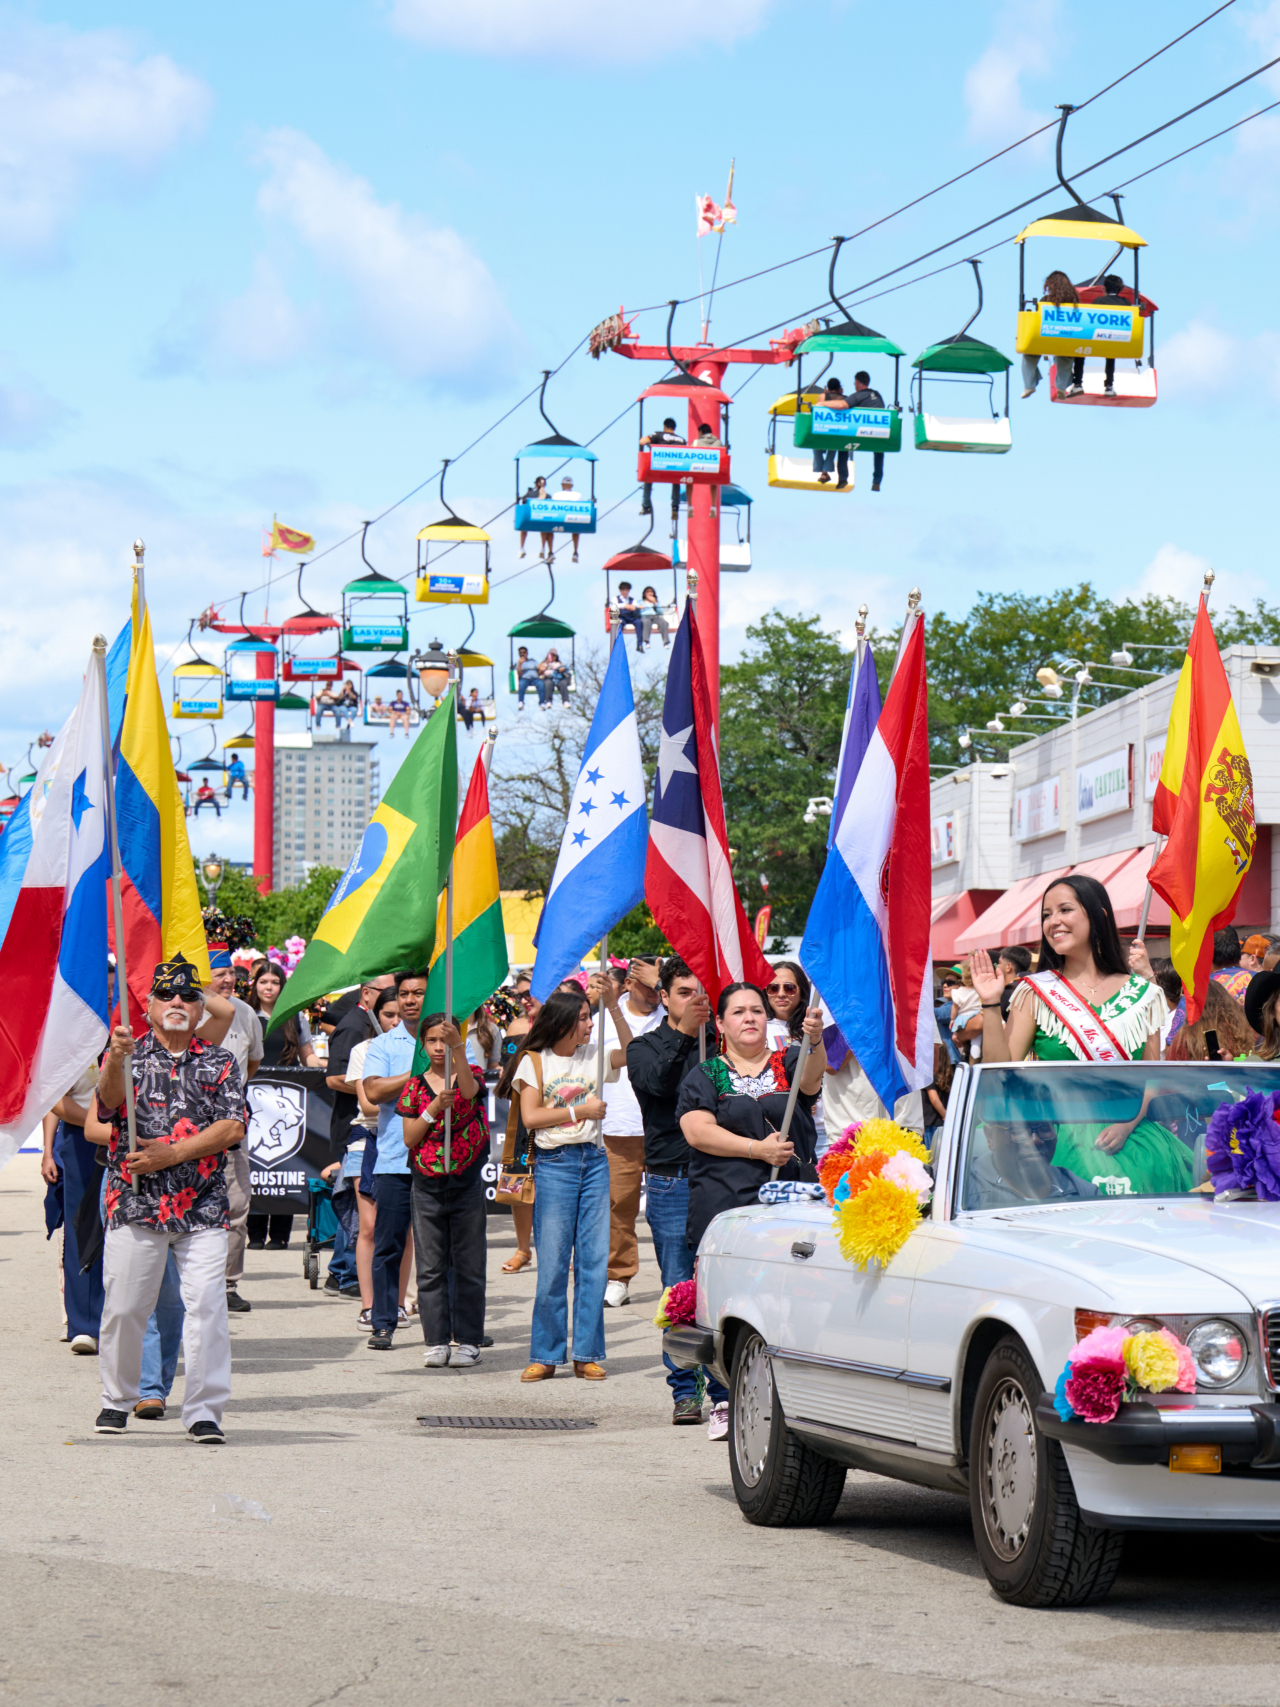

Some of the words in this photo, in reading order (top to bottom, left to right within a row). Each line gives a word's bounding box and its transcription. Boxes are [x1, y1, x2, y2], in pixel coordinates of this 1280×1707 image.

[1044, 309, 1083, 323] NEW
[1087, 312, 1132, 327] YORK
[1074, 346, 1093, 355] 48
[814, 411, 890, 425] NASHVILLE
[653, 451, 718, 461] MINNEAPOLIS
[551, 505, 590, 513] ANGELES
[234, 681, 274, 689] HOUSTON
[181, 701, 218, 709] DETROIT
[1080, 1025, 1099, 1044] Ms.
[251, 1187, 286, 1196] LIONS
